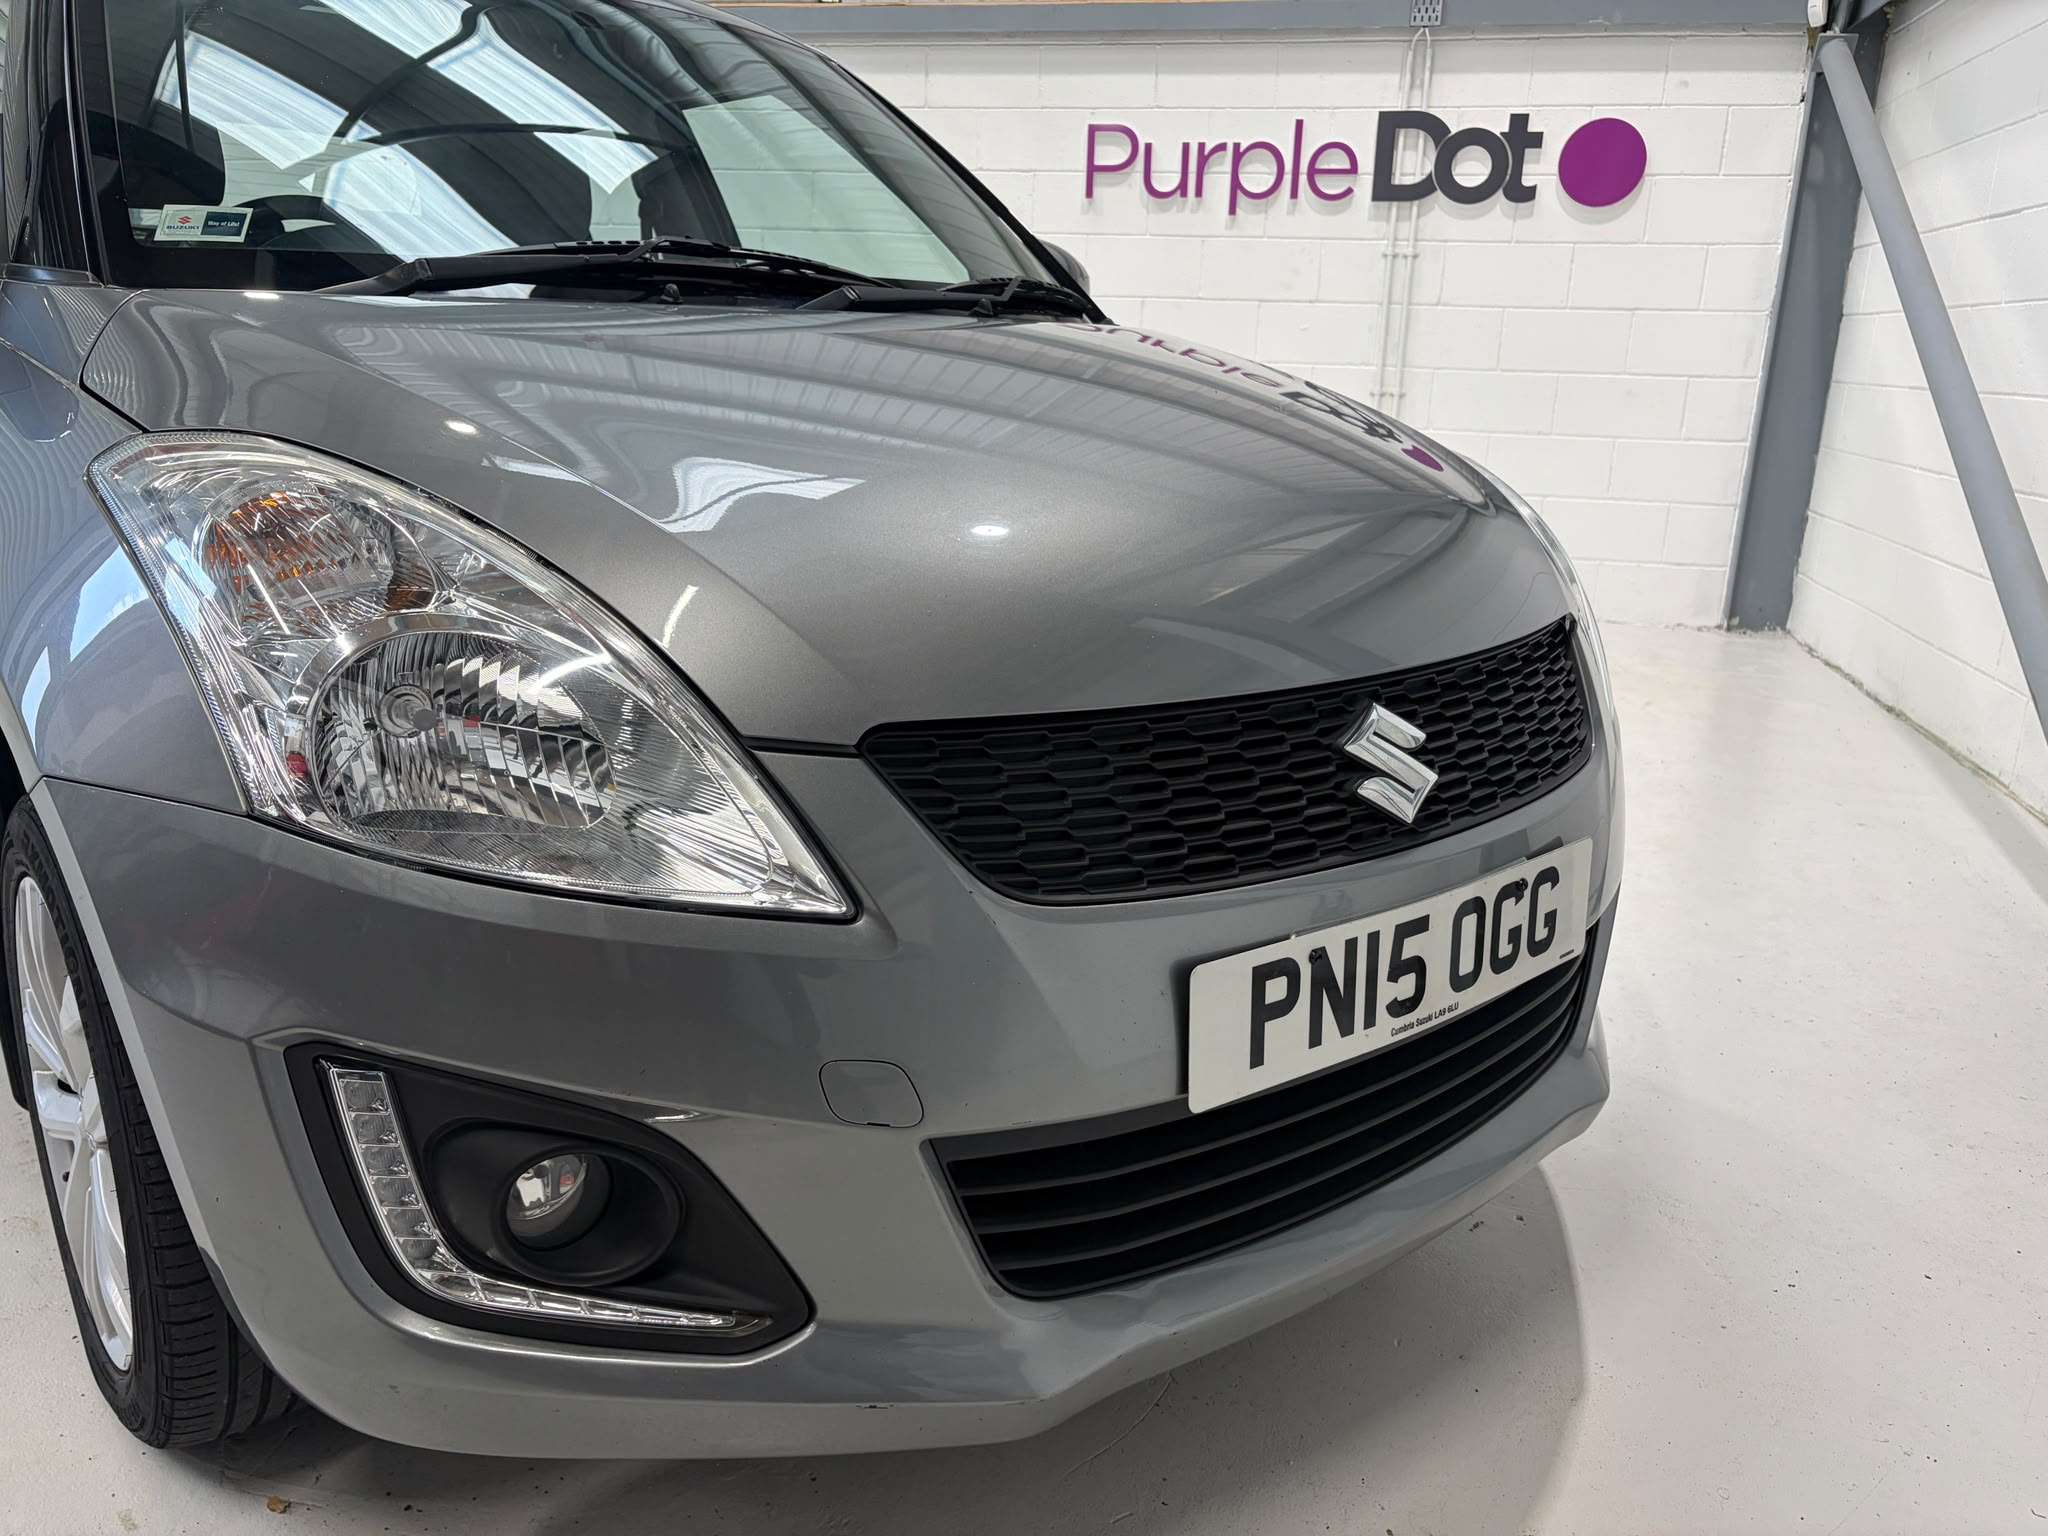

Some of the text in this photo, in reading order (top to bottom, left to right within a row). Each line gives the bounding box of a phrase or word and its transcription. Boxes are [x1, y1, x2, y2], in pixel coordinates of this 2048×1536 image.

[1250, 866, 1560, 1070] PN15 OGG
[1391, 1021, 1415, 1037] Cumbria
[1415, 1012, 1433, 1027] Suzuki
[1434, 1008, 1447, 1019] LA9
